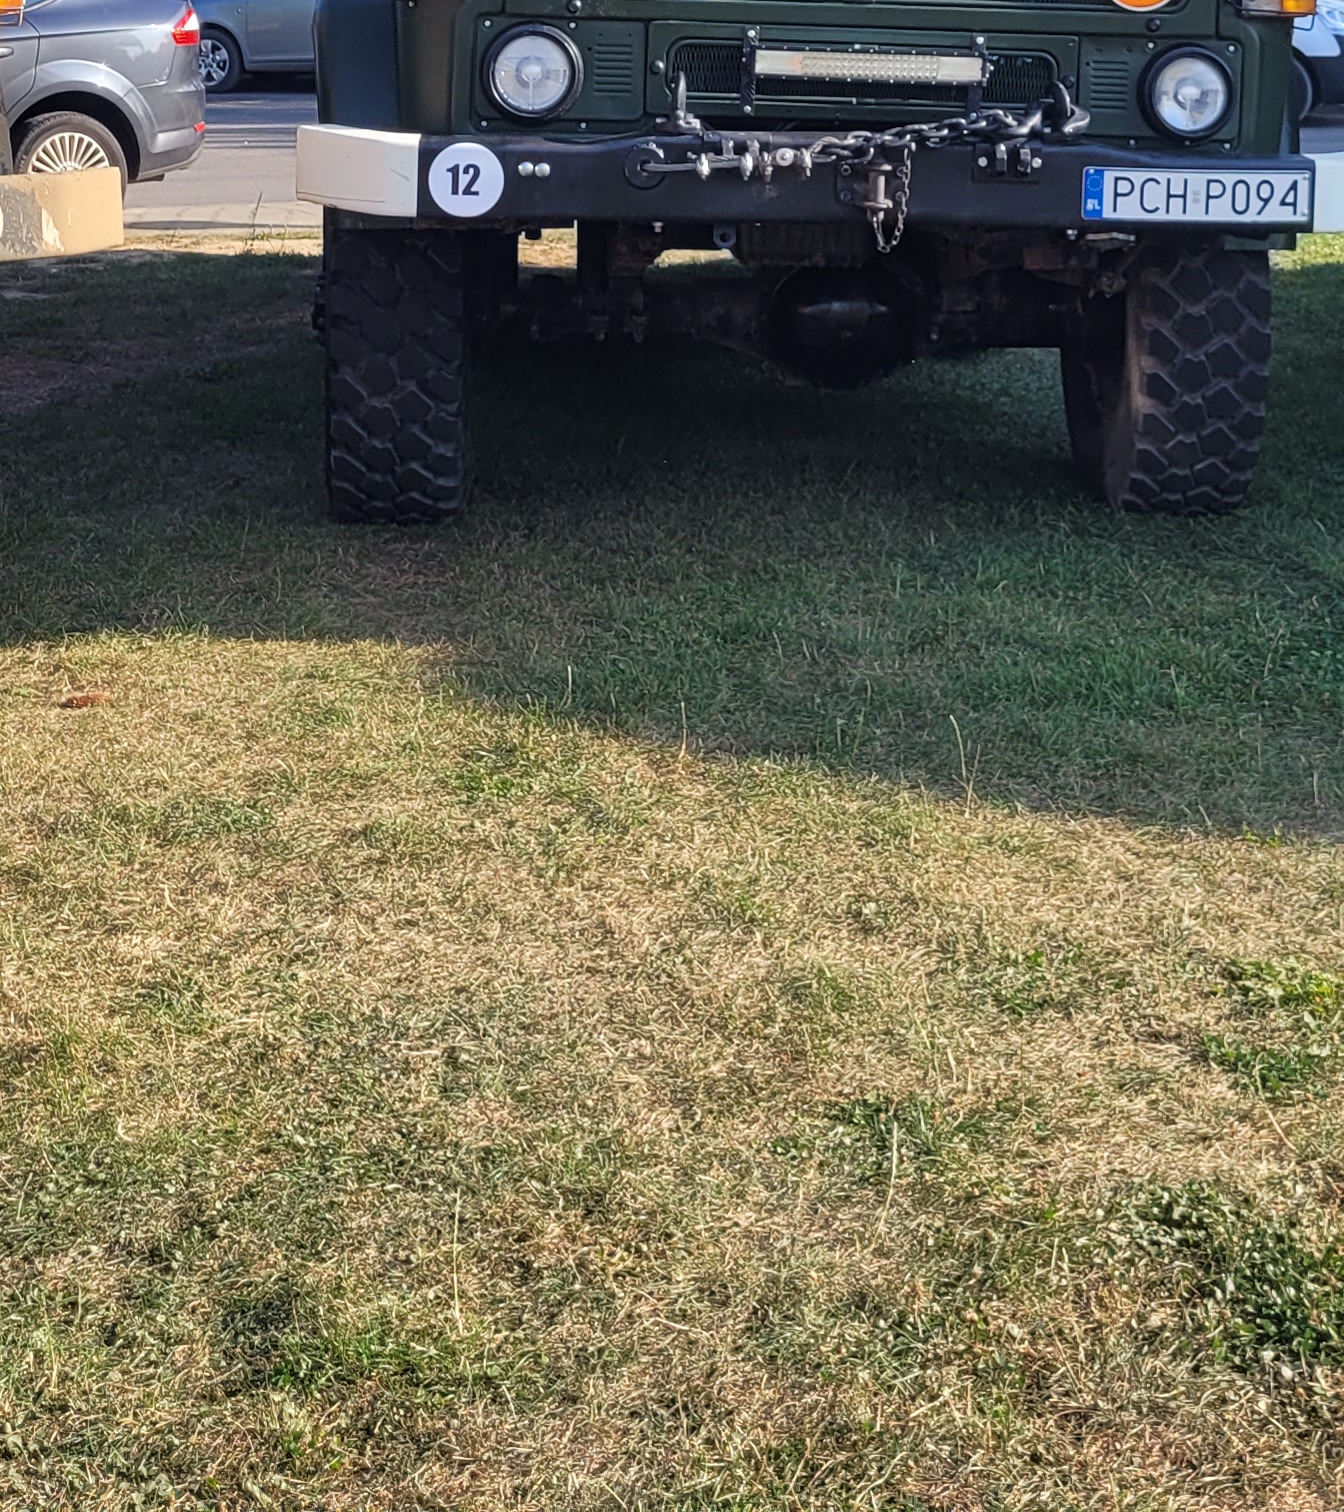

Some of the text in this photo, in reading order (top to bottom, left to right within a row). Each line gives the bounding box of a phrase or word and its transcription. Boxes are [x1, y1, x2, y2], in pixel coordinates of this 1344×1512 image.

[445, 163, 481, 197] 12
[1113, 176, 1299, 216] PCH P094
